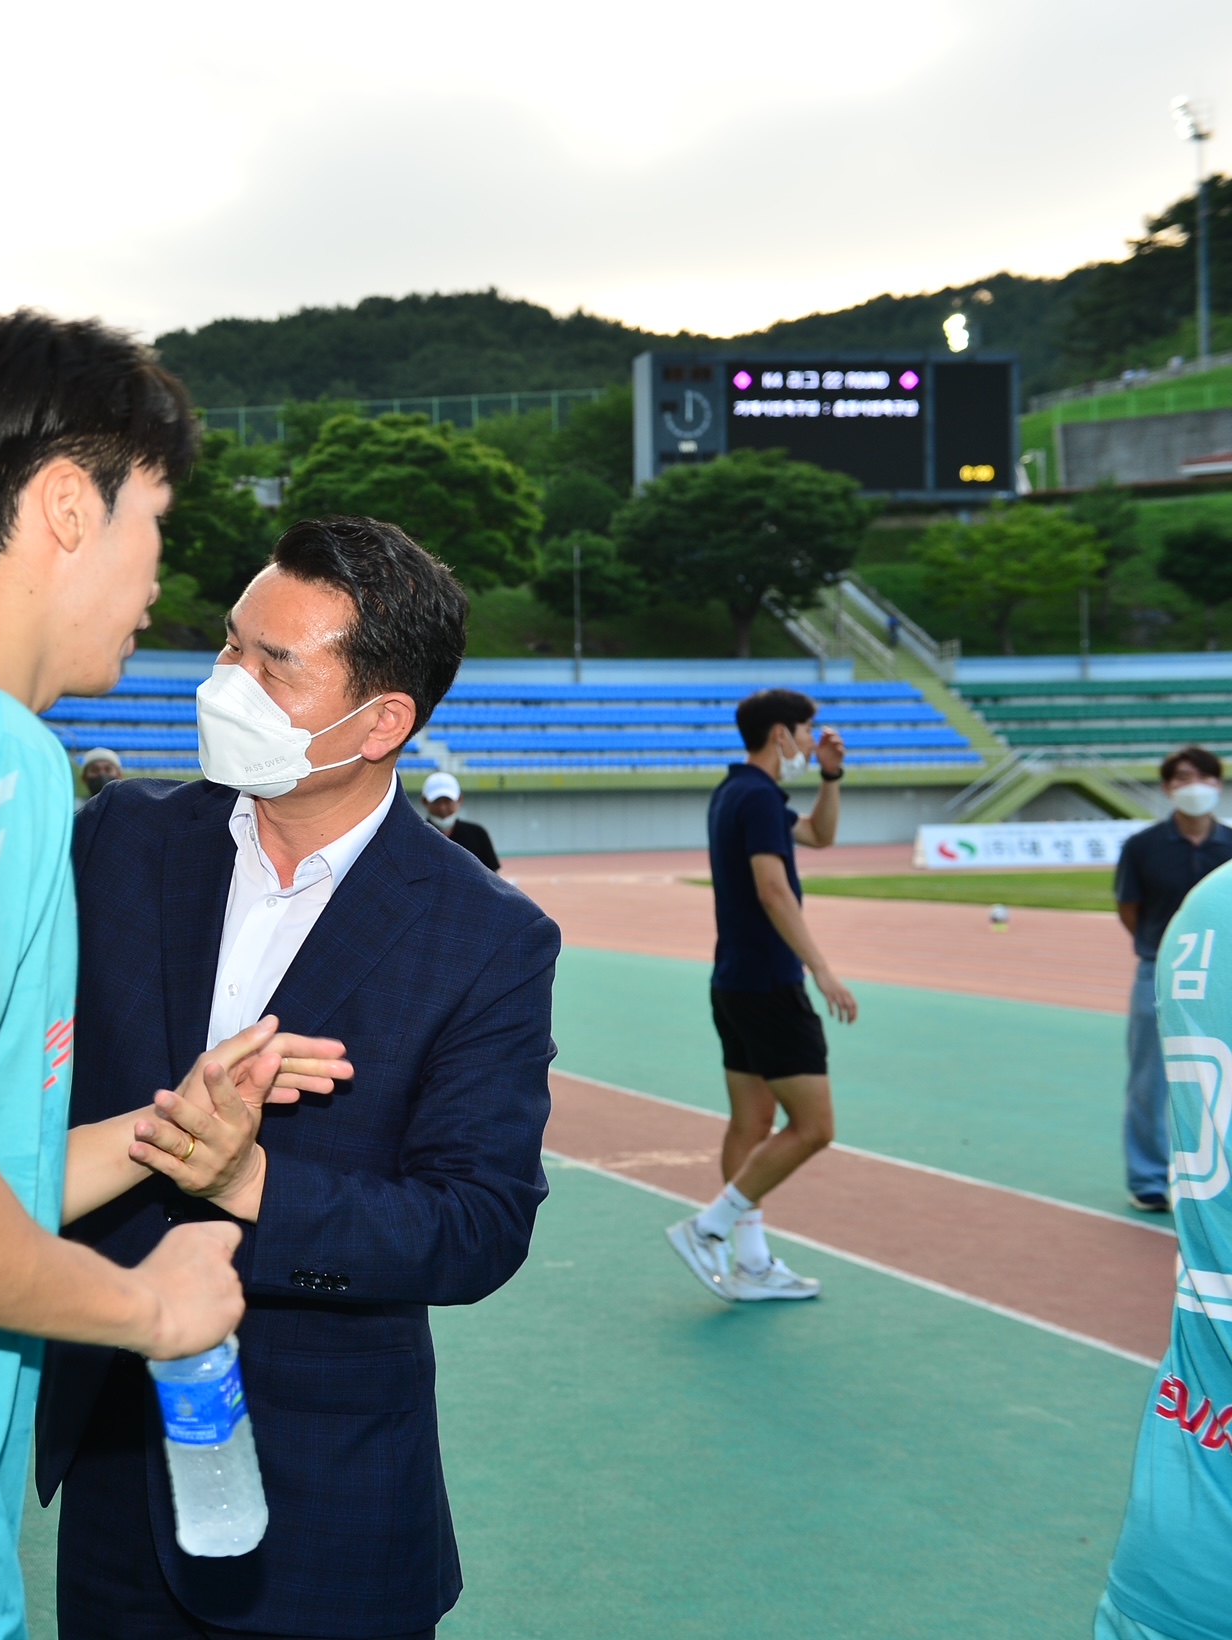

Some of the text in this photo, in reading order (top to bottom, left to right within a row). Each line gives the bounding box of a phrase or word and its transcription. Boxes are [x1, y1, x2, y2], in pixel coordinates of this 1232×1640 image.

[244, 755, 287, 773] PASS OVER
[1171, 929, 1215, 999] 김
